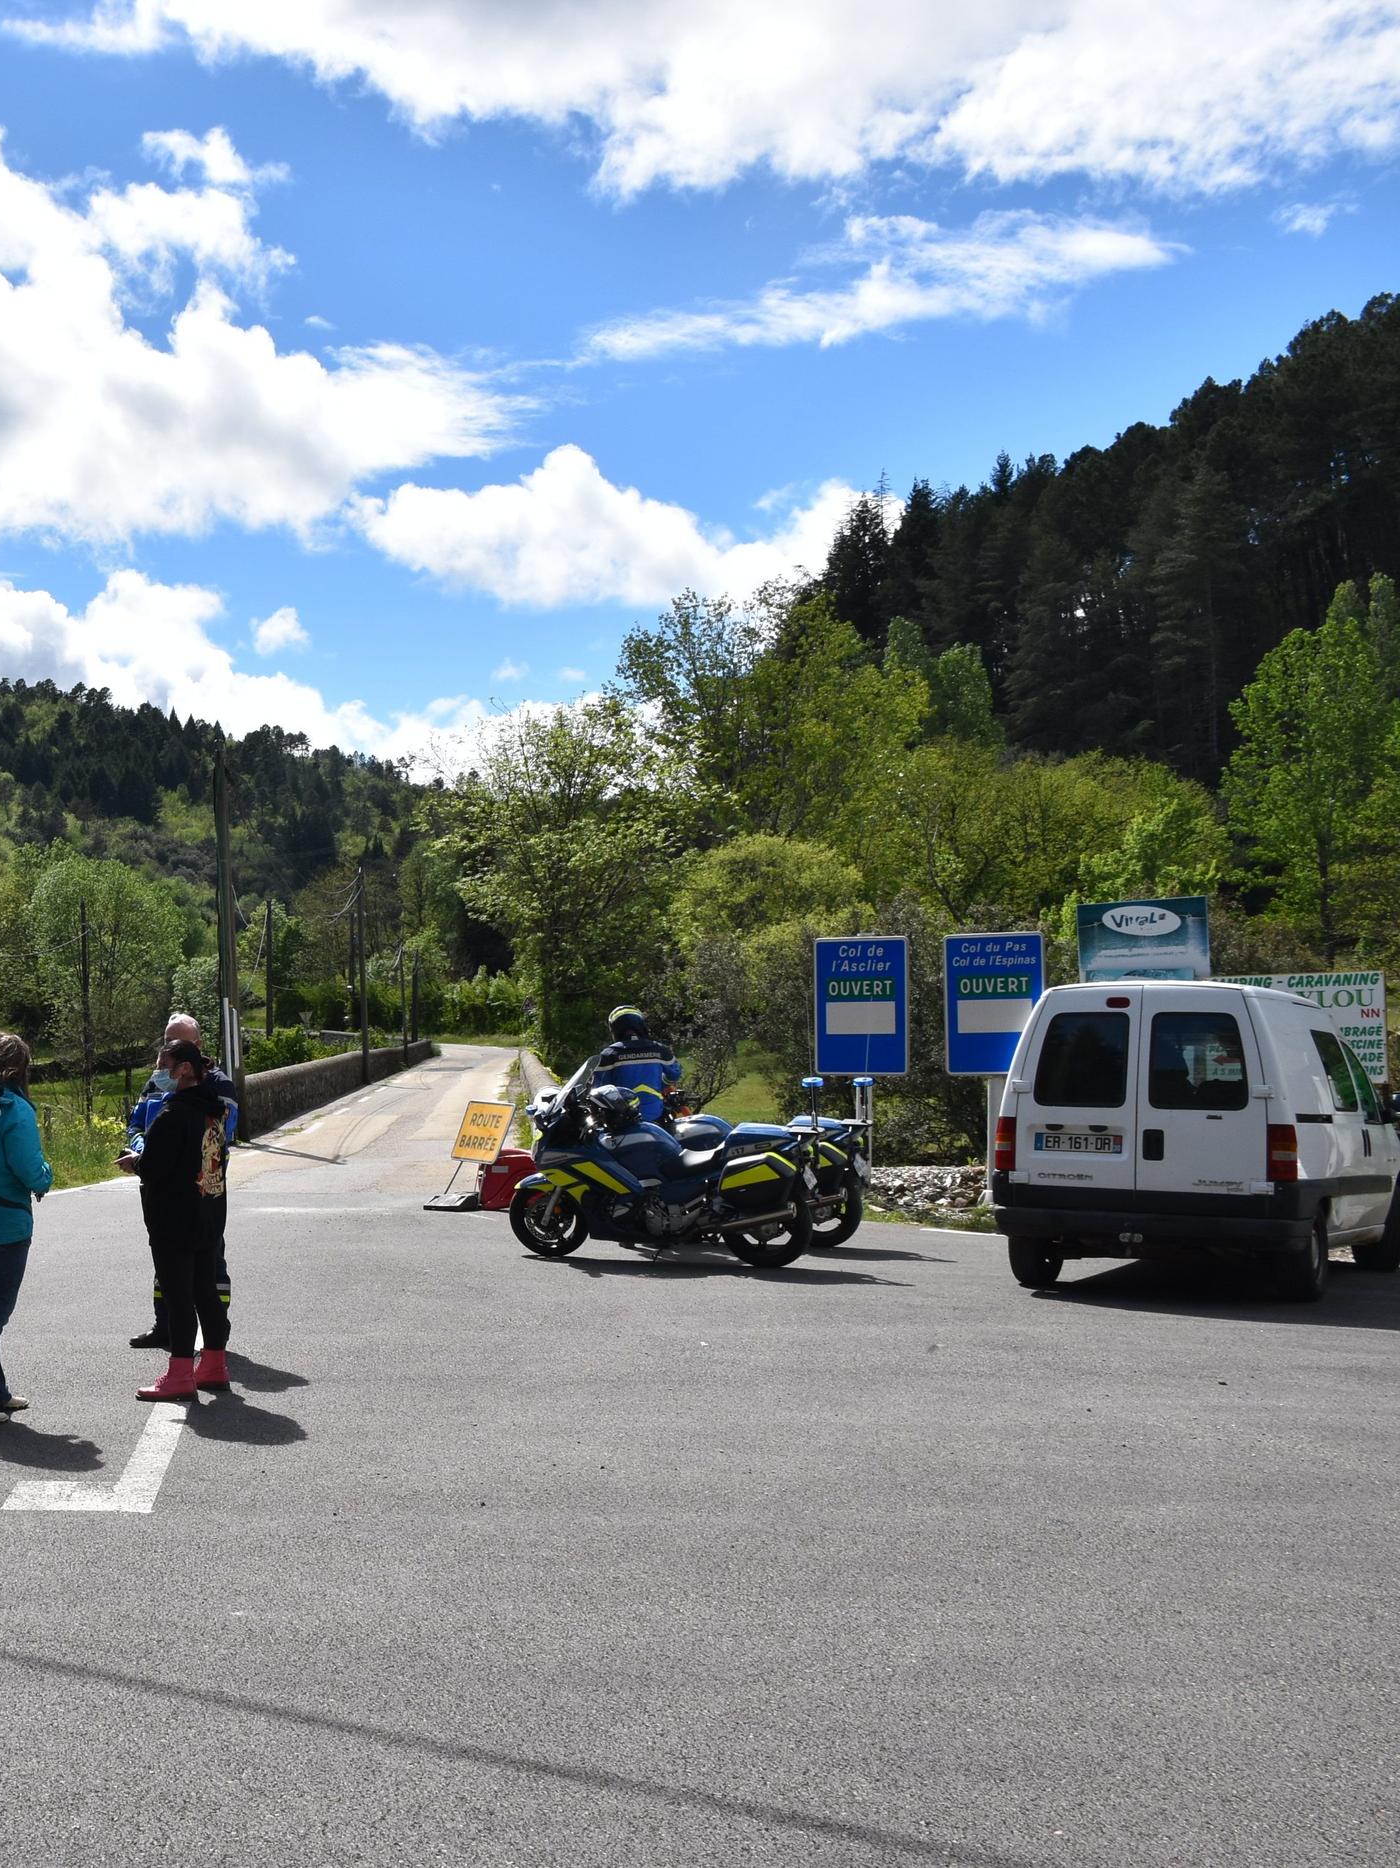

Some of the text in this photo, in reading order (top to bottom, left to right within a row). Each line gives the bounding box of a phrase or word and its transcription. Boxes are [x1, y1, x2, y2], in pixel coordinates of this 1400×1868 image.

[839, 944, 884, 957] Col de
[961, 941, 1027, 954] Col du Pas
[831, 960, 892, 972] l'Asclier
[952, 956, 970, 967] Col
[973, 956, 986, 967] de
[960, 977, 1029, 994] OUVERT
[1287, 973, 1380, 988] CARAVANING
[828, 981, 893, 996] OUVERT
[1360, 1008, 1380, 1018] NN
[1340, 1023, 1383, 1037] BRAGÉ
[1348, 1039, 1383, 1050] SCINE
[1357, 1052, 1384, 1062] ADE
[469, 1113, 502, 1129] ROUTE
[459, 1134, 499, 1151] BARRÉE
